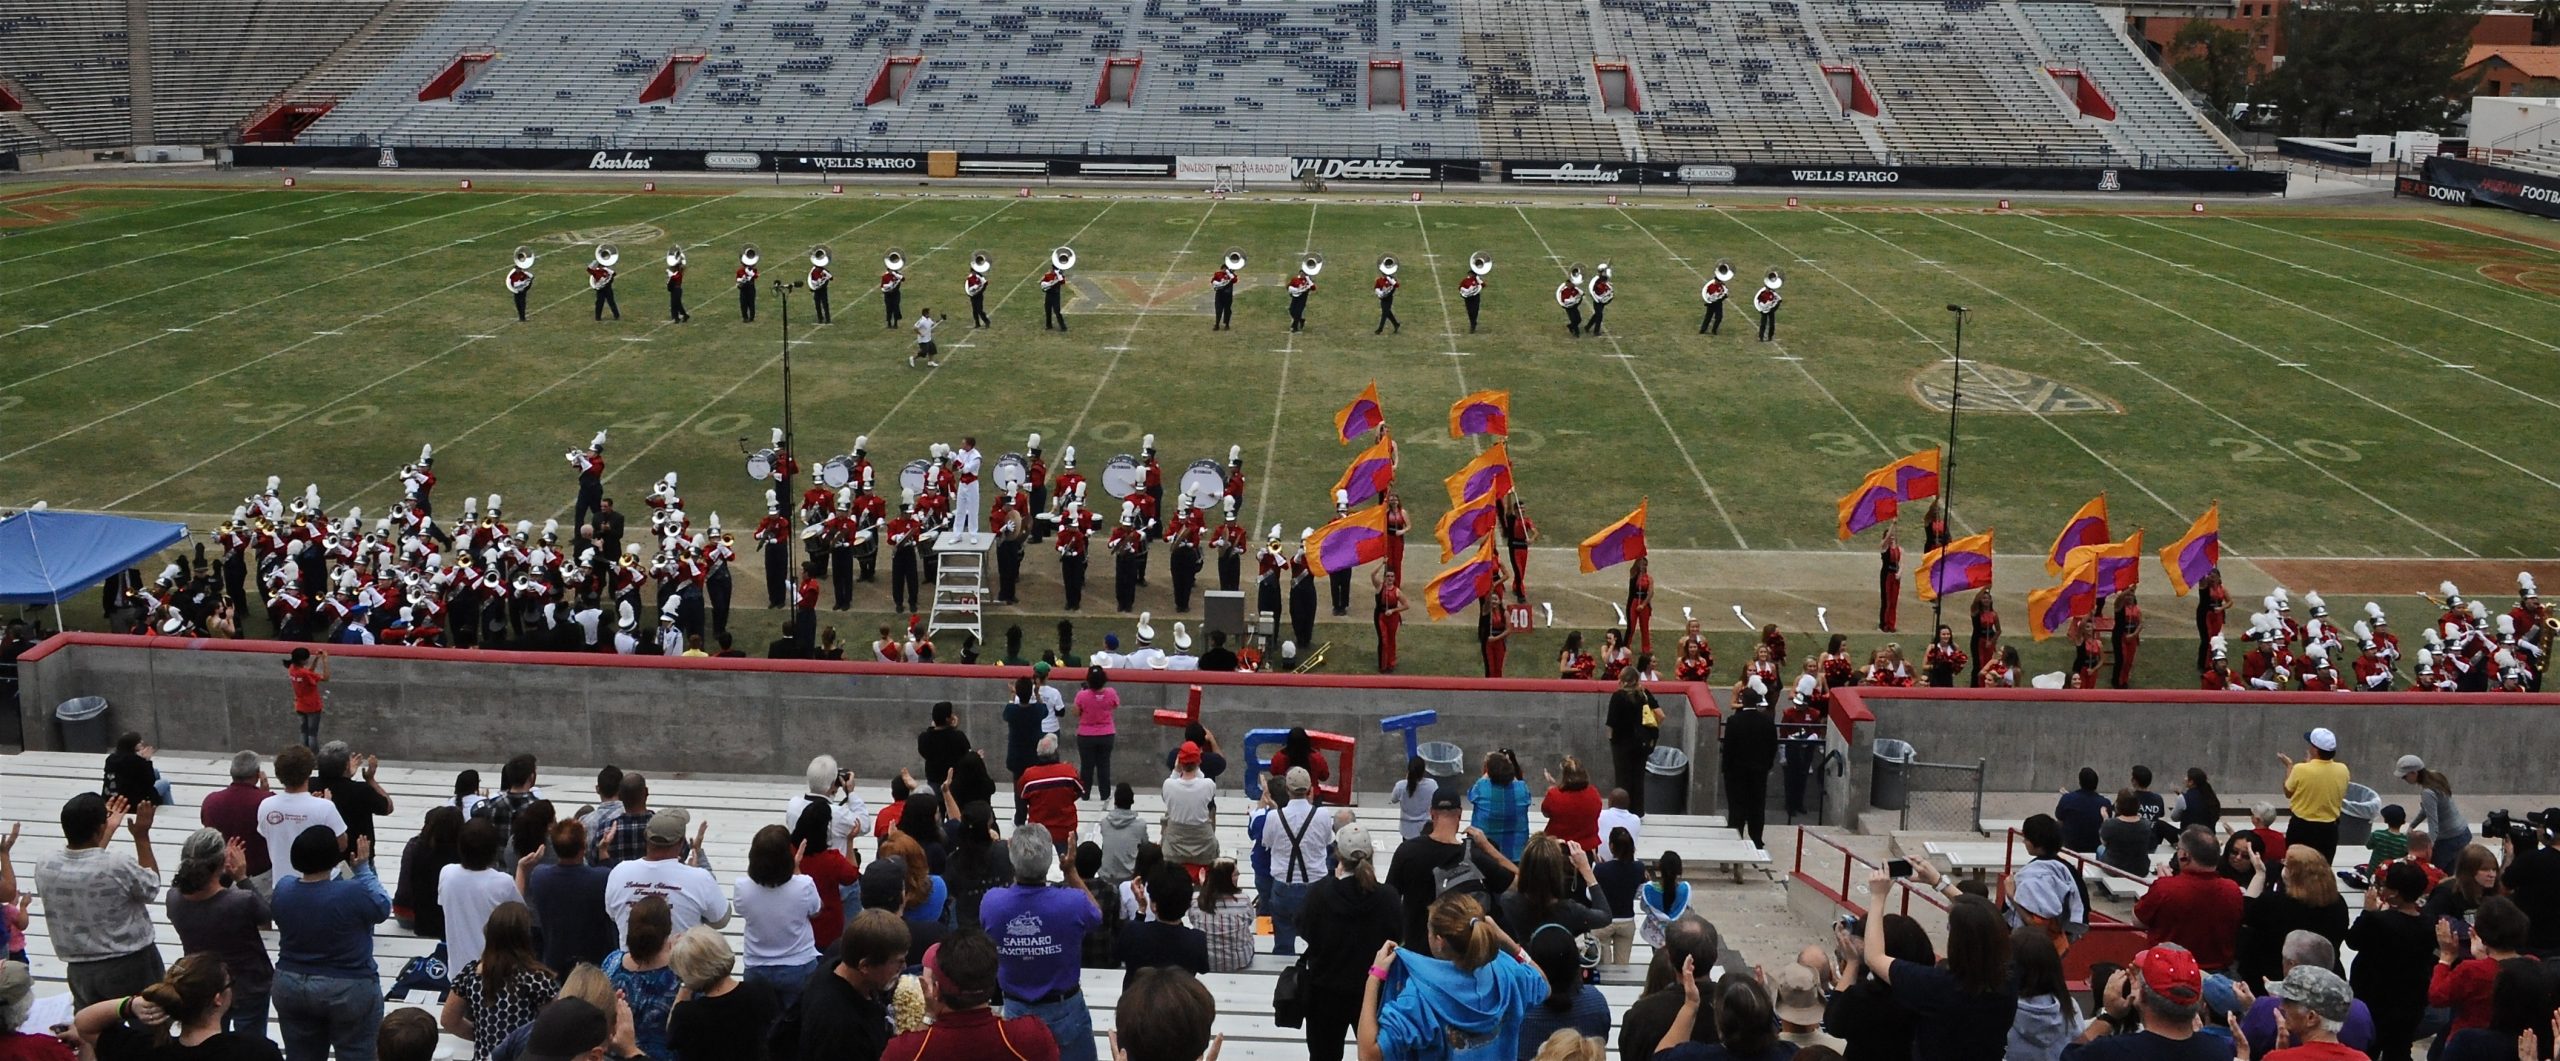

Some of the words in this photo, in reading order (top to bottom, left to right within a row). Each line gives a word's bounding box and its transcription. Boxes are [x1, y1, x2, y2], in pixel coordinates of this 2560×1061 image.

[589, 151, 653, 169] Bashas'
[814, 157, 864, 169] WELLS
[867, 158, 916, 169] FARGO
[1180, 163, 1214, 173] UNIVERSITY
[1275, 164, 1288, 174] DAY
[1792, 170, 1845, 181] WELLS
[1847, 171, 1899, 182] FARGO
[2429, 185, 2465, 203] DOWN
[1511, 608, 1529, 629] 40
[1003, 935, 1052, 947] SAHUARO
[996, 944, 1063, 956] SAXOPHONES
